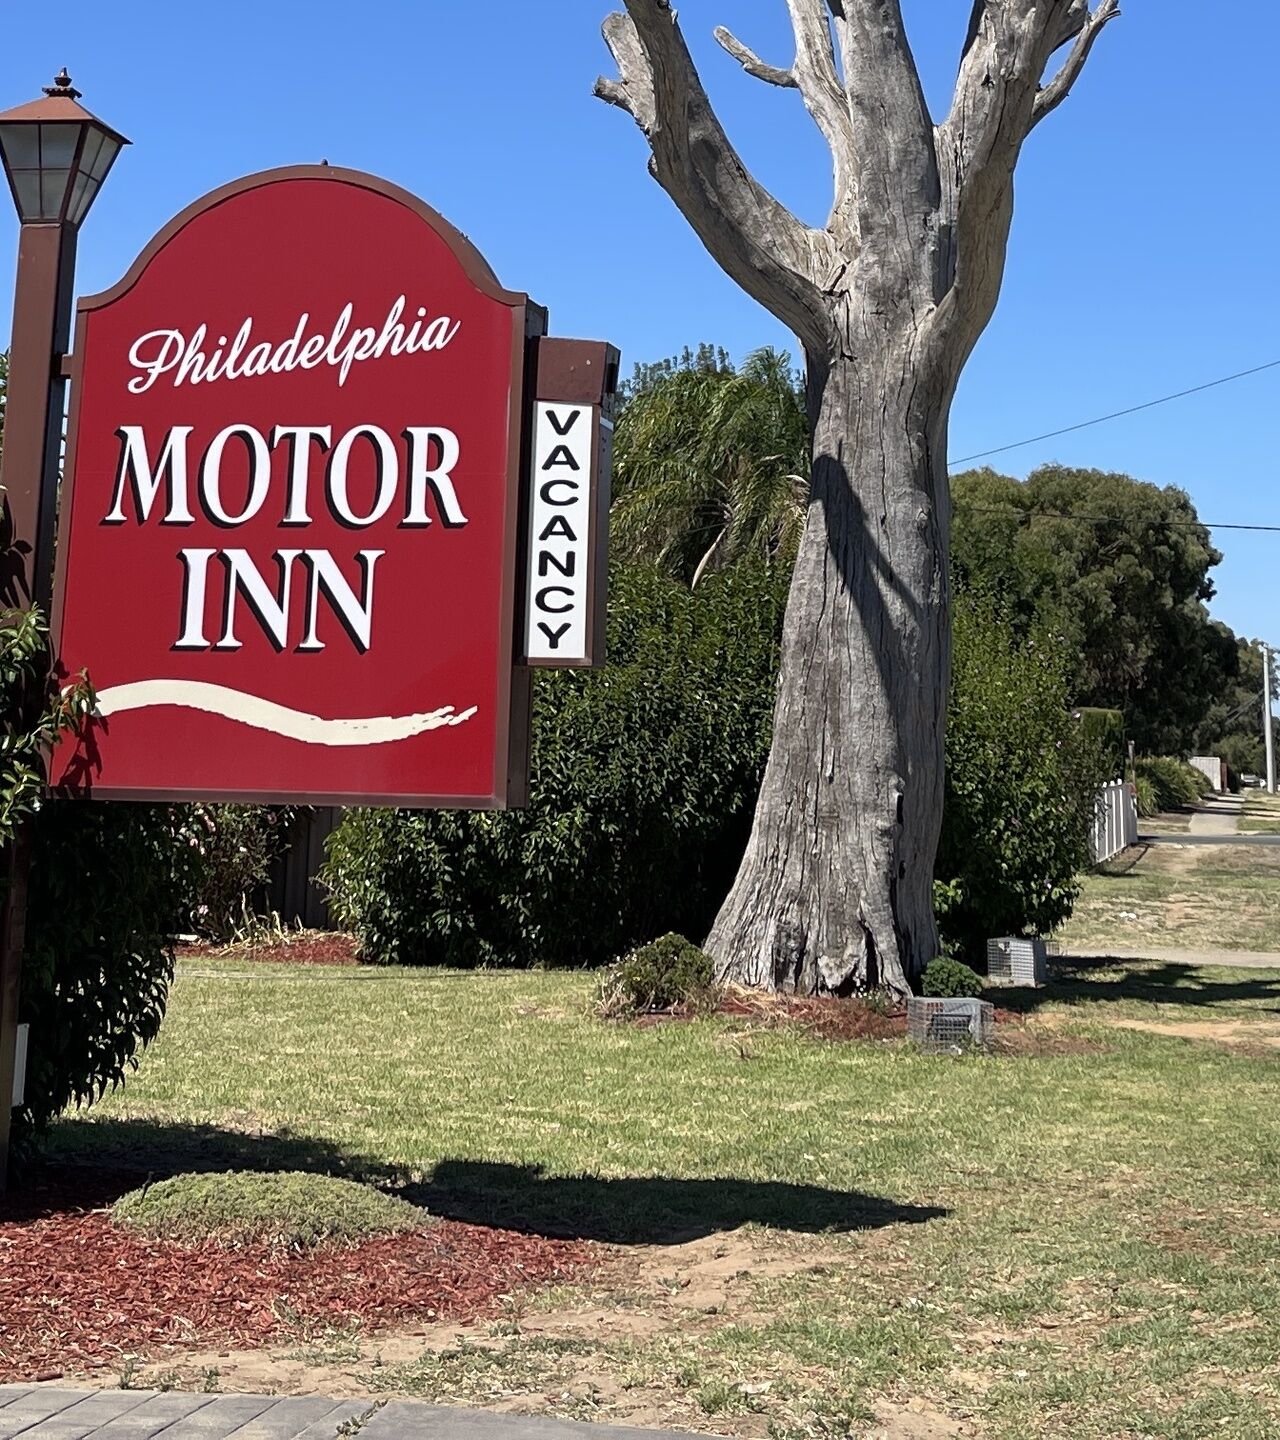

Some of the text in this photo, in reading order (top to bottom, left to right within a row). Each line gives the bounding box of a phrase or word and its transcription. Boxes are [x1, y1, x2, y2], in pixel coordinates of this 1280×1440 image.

[127, 294, 461, 394] Philadelphia
[100, 423, 469, 530] MOTOR
[534, 409, 581, 651] VACANCY
[171, 547, 386, 654] INN
